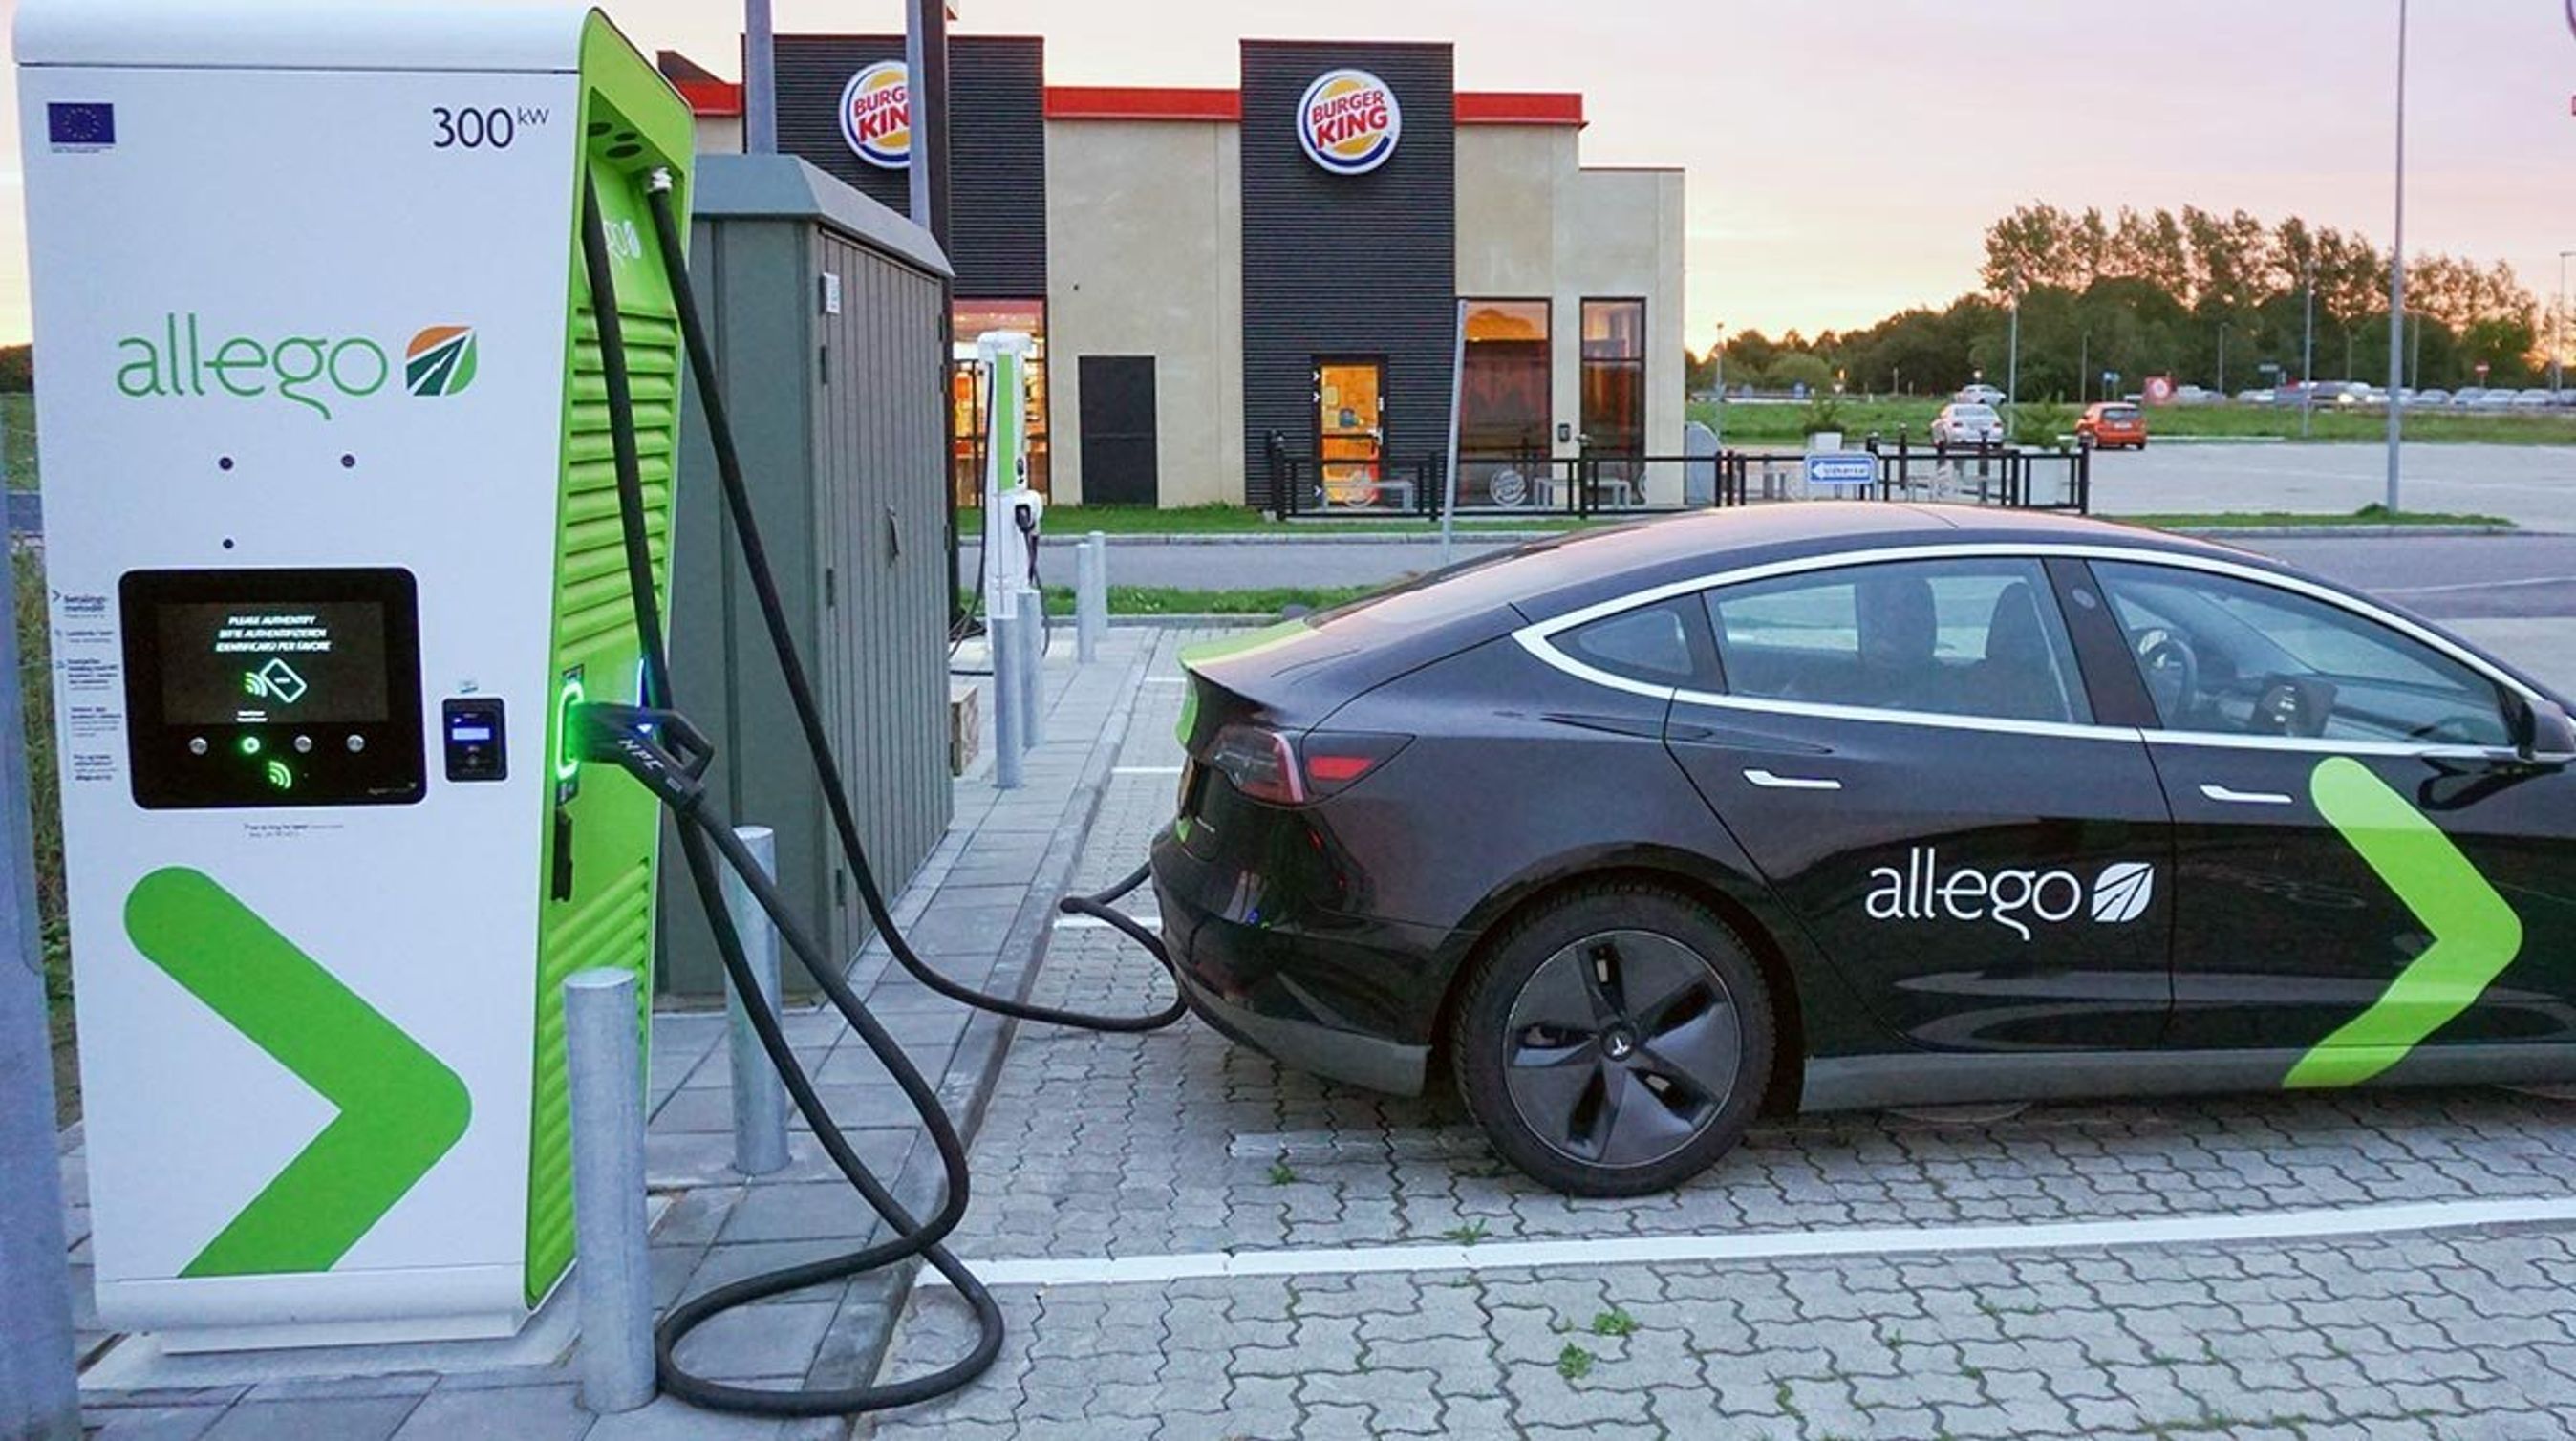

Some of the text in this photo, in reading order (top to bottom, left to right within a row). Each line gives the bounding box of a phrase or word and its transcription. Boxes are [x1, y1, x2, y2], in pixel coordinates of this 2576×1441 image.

[853, 85, 906, 117] BURG
[1312, 90, 1385, 124] BURGER
[432, 107, 514, 148] 300
[858, 103, 910, 142] KIN
[1317, 106, 1387, 148] KING
[117, 312, 389, 421] allego
[1865, 847, 2082, 941] allego
